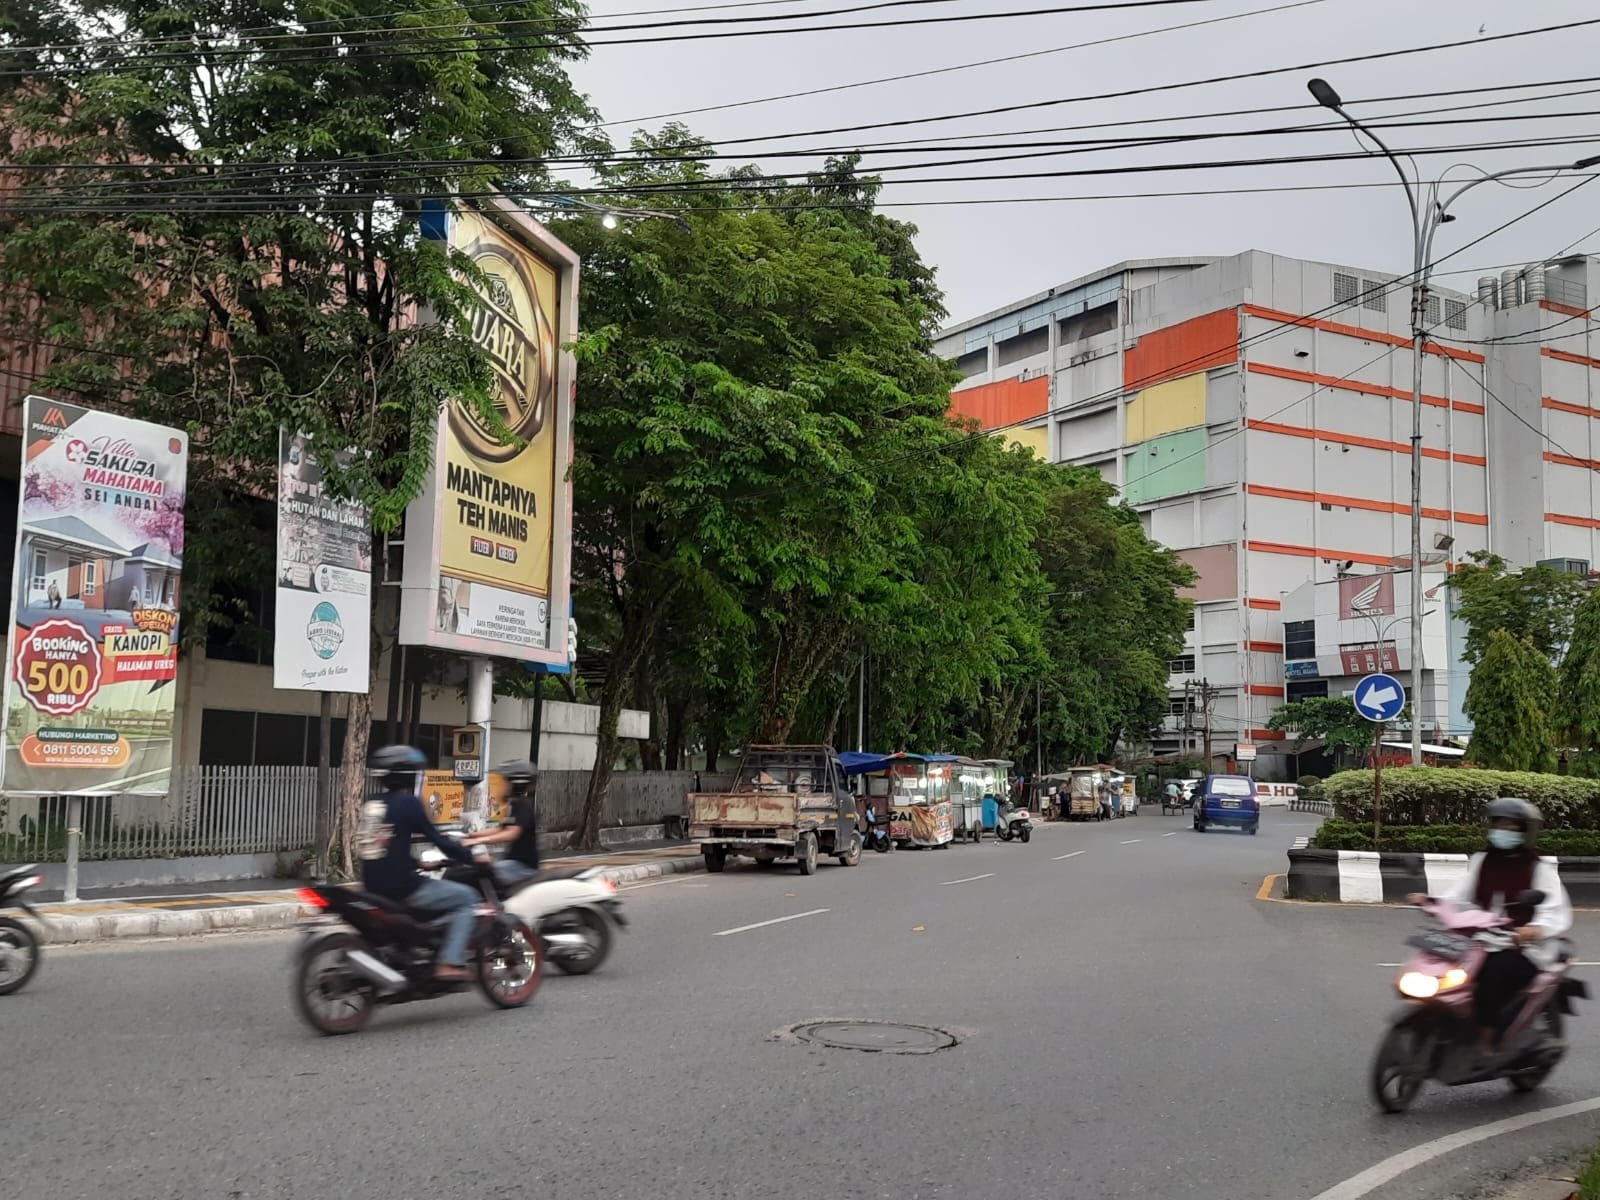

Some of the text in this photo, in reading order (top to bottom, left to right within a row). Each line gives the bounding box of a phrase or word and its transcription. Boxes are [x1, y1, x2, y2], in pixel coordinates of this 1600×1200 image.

[461, 305, 526, 387] UARA
[91, 435, 136, 457] Villa
[84, 450, 156, 478] SAKURA
[82, 467, 163, 496] MAHATAMA
[446, 461, 537, 519] MANTAPNYA
[84, 488, 158, 512] SEI ANDAI
[291, 500, 365, 528] HUTAN DAN LAHAN
[457, 498, 528, 543] TEH MANIS
[133, 609, 176, 626] DISKON
[32, 636, 89, 654] BOOKING
[112, 634, 162, 652] KANOPI
[45, 651, 78, 661] HANYA
[28, 660, 89, 695] 500
[46, 693, 76, 706] RIBU
[38, 730, 117, 741] HUBUNGI MARKETING
[42, 744, 120, 756] 0811 5004 559
